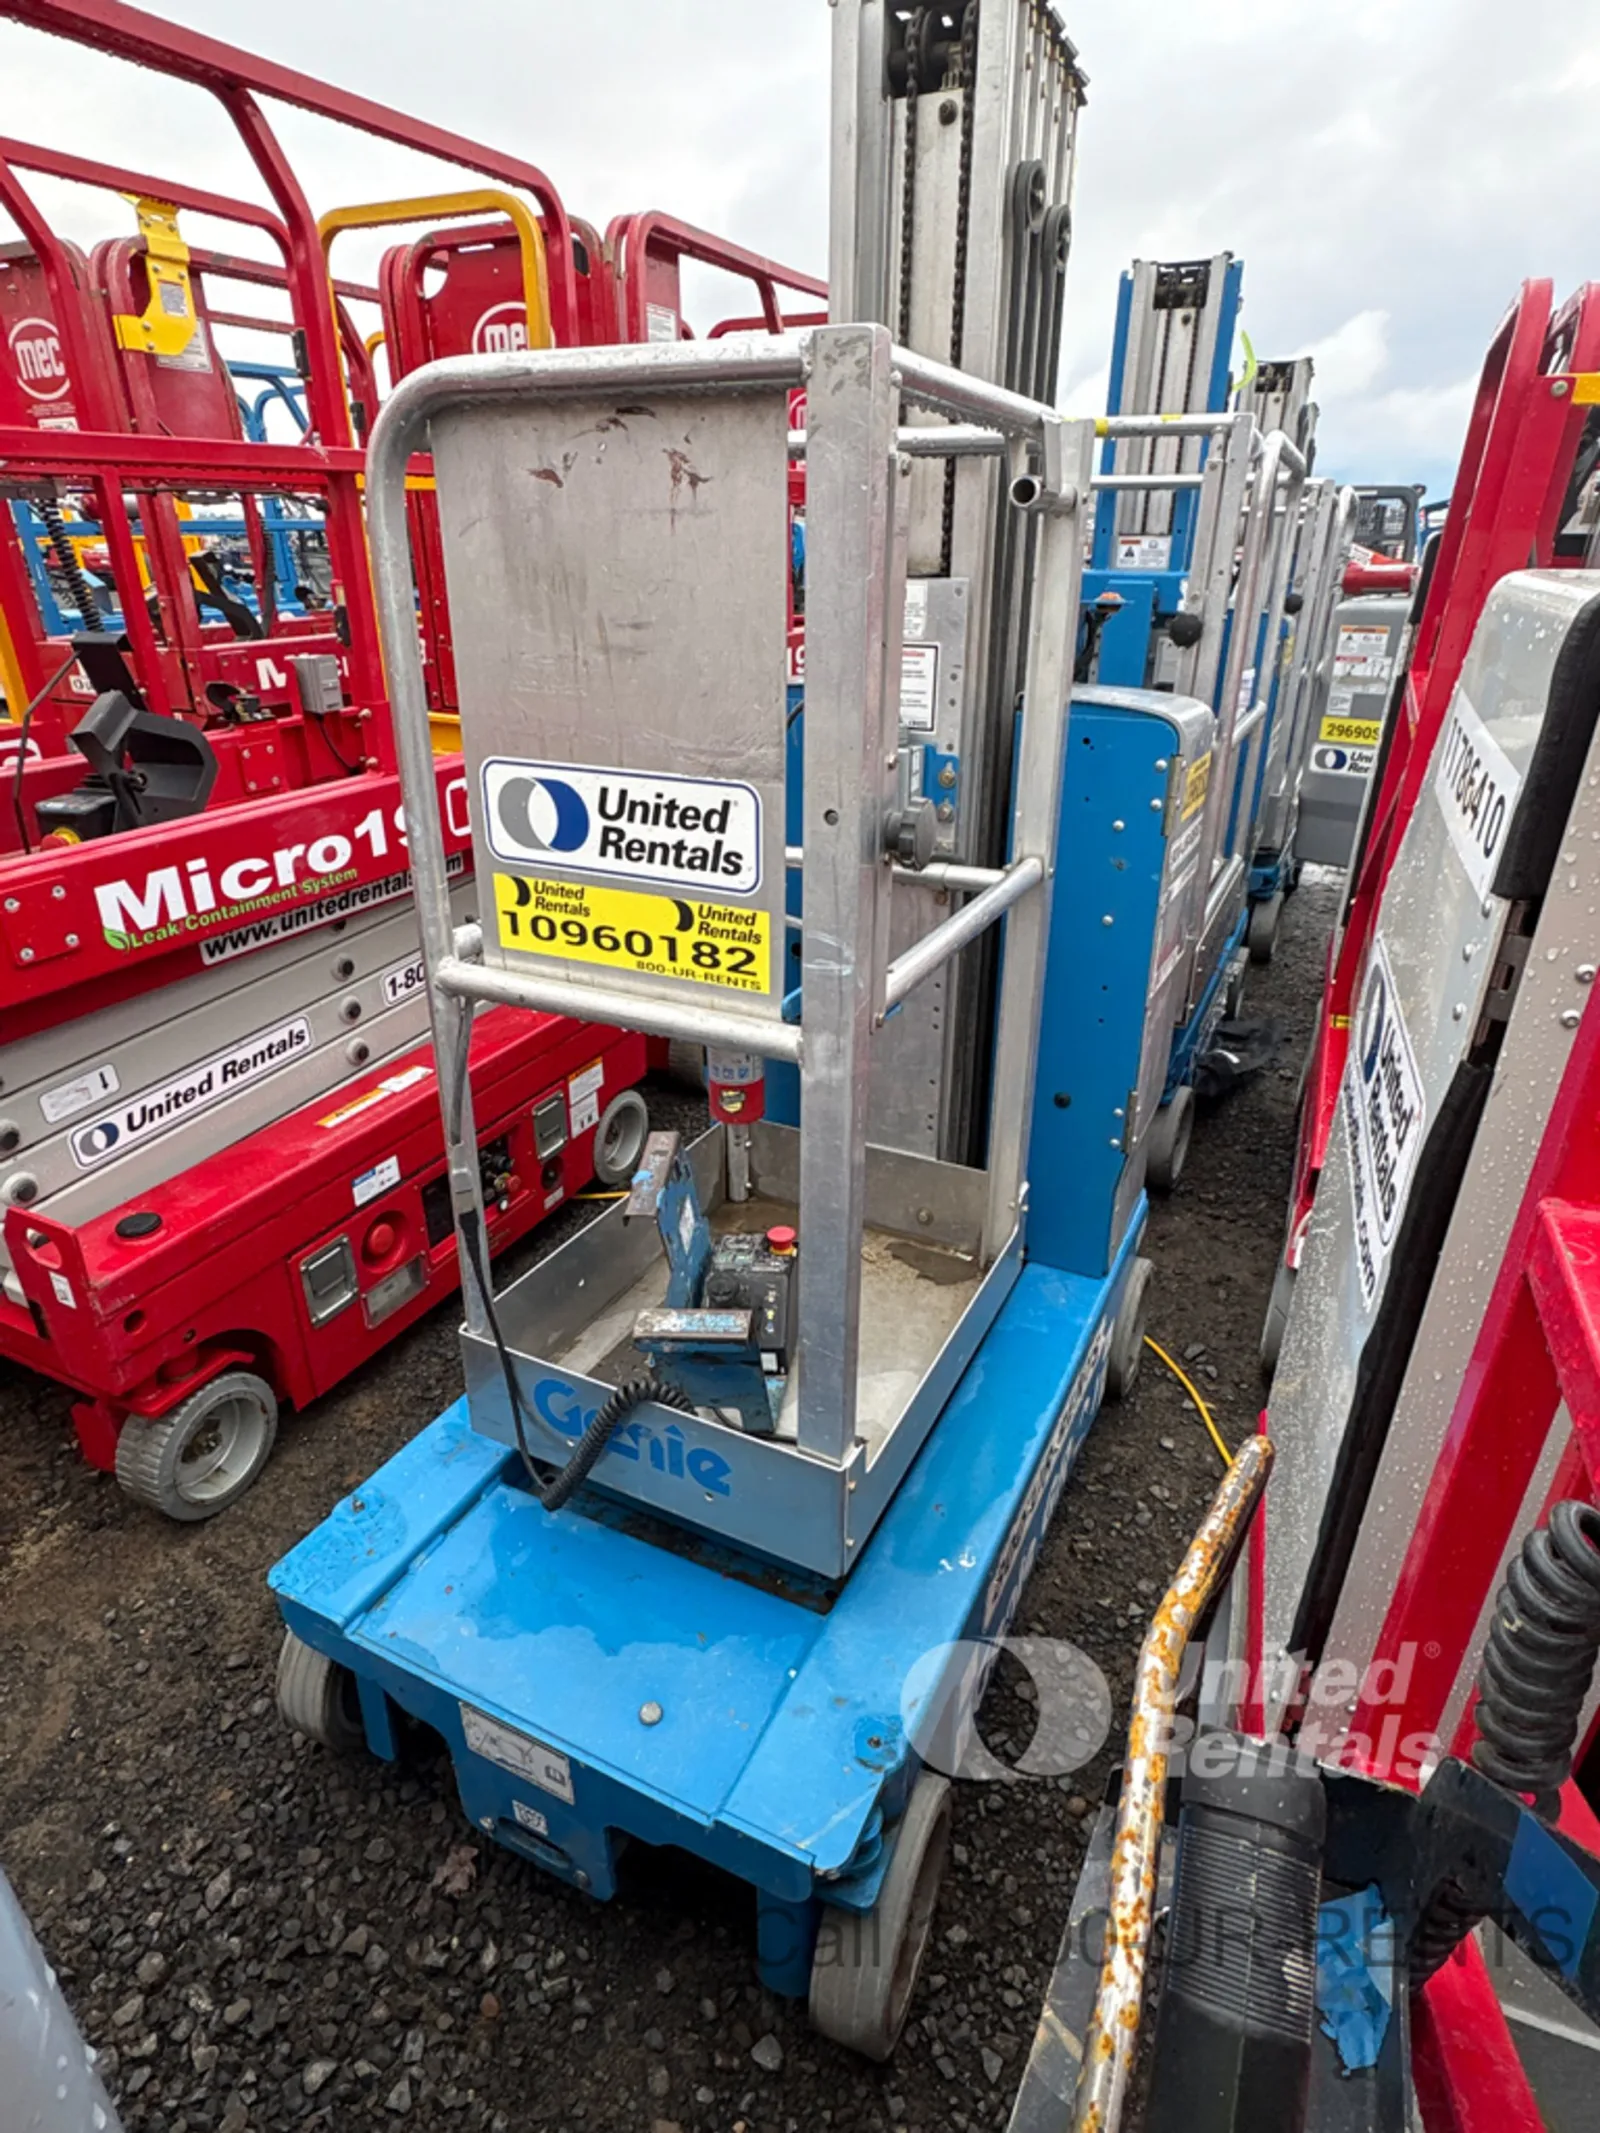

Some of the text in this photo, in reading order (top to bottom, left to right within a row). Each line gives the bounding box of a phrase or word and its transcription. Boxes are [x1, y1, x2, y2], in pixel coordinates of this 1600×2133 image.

[15, 336, 66, 381] mec
[484, 322, 529, 353] me
[597, 786, 732, 834] United
[598, 825, 744, 877] Rentals
[130, 866, 358, 950] Leak Containment System
[204, 851, 462, 960] www.unitedrentalm
[533, 880, 586, 901] United
[534, 896, 591, 918] Rentals
[698, 904, 757, 927] United
[698, 921, 763, 945] Rentals
[502, 910, 758, 977] 10960182
[635, 960, 762, 992] 800-UR-RENTS
[125, 1071, 214, 1133] United
[220, 1027, 307, 1084] Rentals
[1381, 1016, 1415, 1153] United
[1366, 1071, 1397, 1223] Rentals
